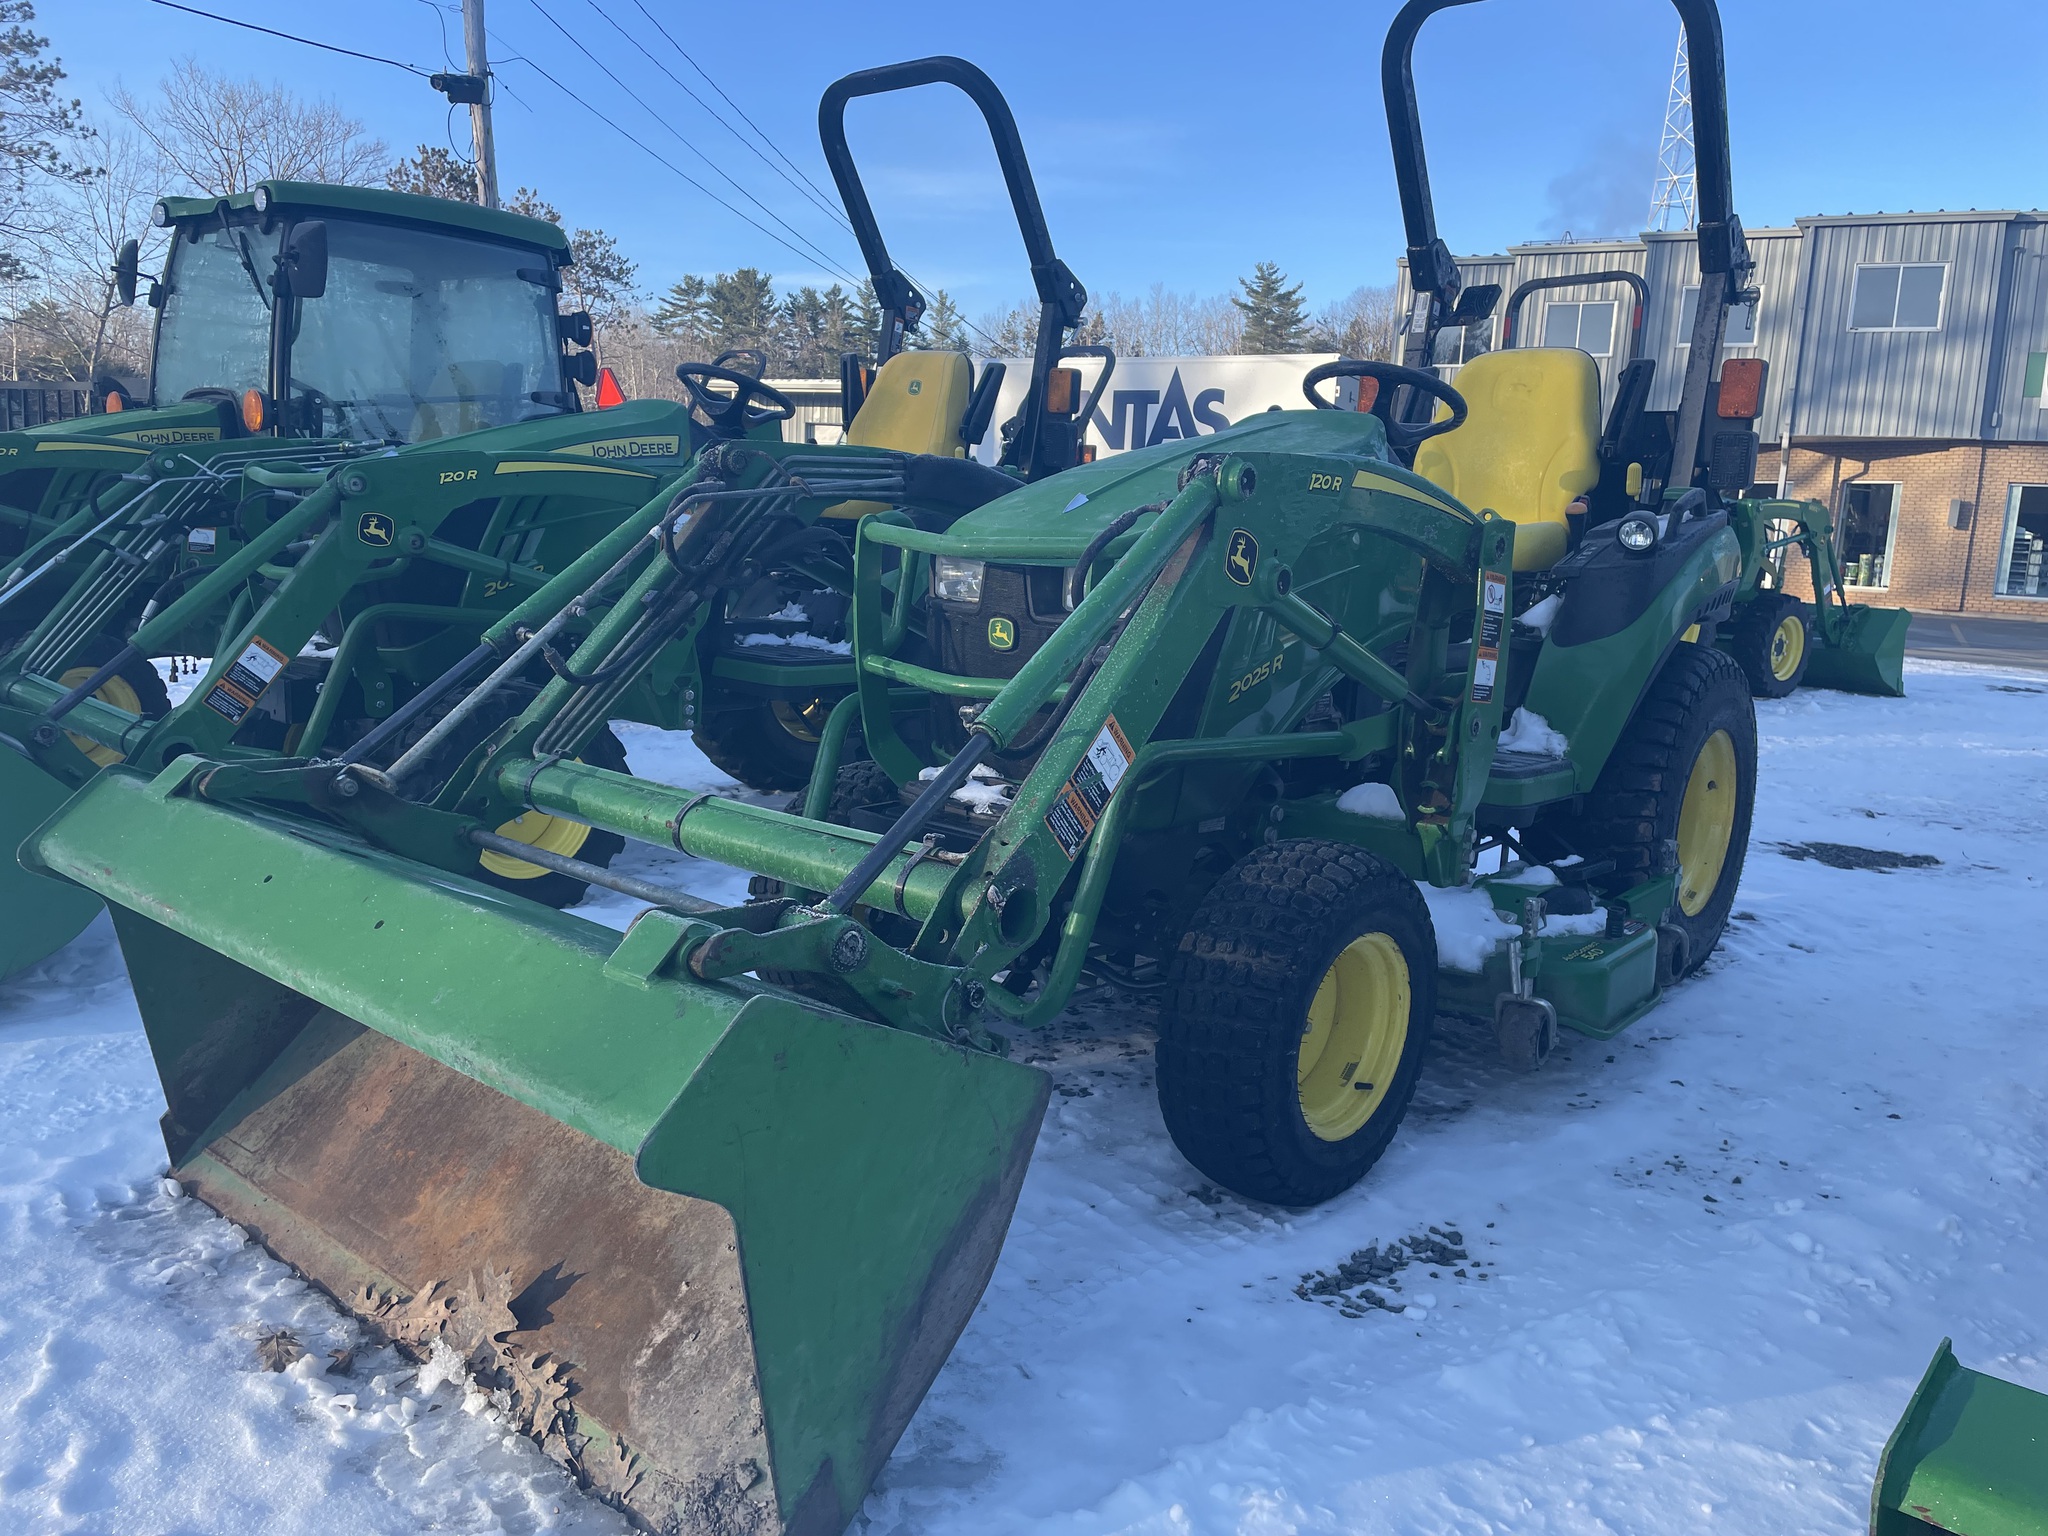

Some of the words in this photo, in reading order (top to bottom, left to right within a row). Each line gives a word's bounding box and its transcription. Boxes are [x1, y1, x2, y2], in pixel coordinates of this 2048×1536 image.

[1079, 365, 1231, 450] NTAS
[136, 432, 170, 443] JOHN
[171, 431, 215, 442] DEERE
[591, 444, 628, 458] JOHN
[629, 441, 674, 455] DEERE
[439, 470, 465, 485] 120
[466, 469, 478, 481] R
[1308, 473, 1332, 491] 120
[1331, 475, 1343, 492] R
[261, 643, 284, 662] WARNING
[1228, 661, 1270, 704] 2025
[1272, 653, 1284, 676] R
[226, 686, 250, 705] WARNING
[1112, 727, 1132, 759] WARNING
[1070, 796, 1089, 828] WARNING
